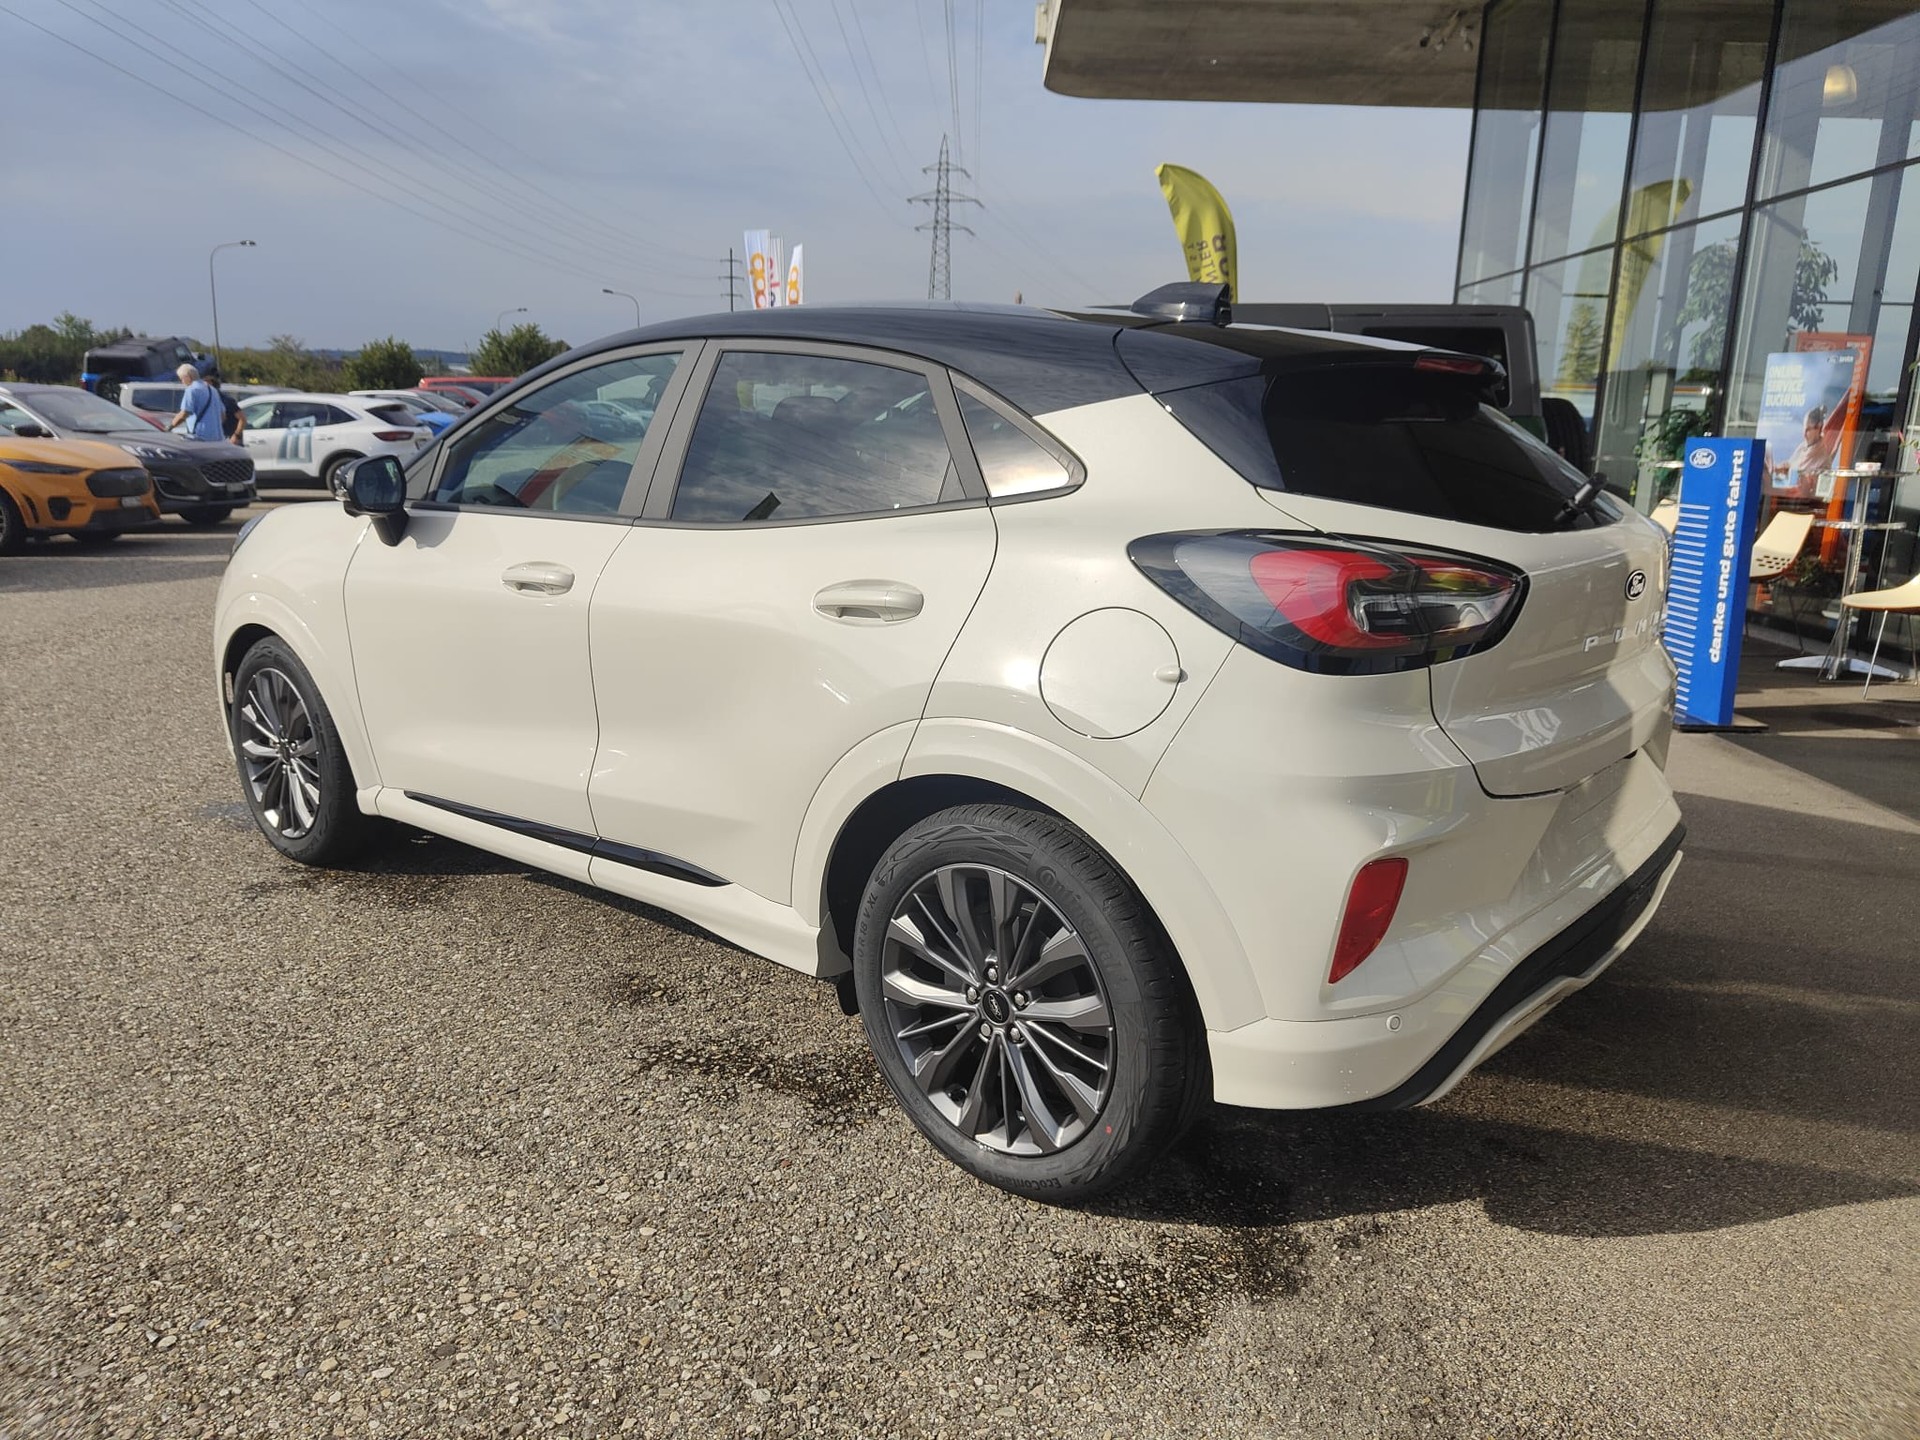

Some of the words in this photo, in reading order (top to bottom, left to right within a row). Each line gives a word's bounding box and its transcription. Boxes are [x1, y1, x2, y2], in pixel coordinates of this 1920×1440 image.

[1768, 380, 1805, 392] SERVICE
[1692, 450, 1713, 467] Ford
[1726, 449, 1745, 508] fahrt!
[1723, 510, 1737, 558] gute
[1628, 572, 1645, 598] Ford
[1718, 559, 1731, 599] und
[1709, 602, 1726, 663] danke
